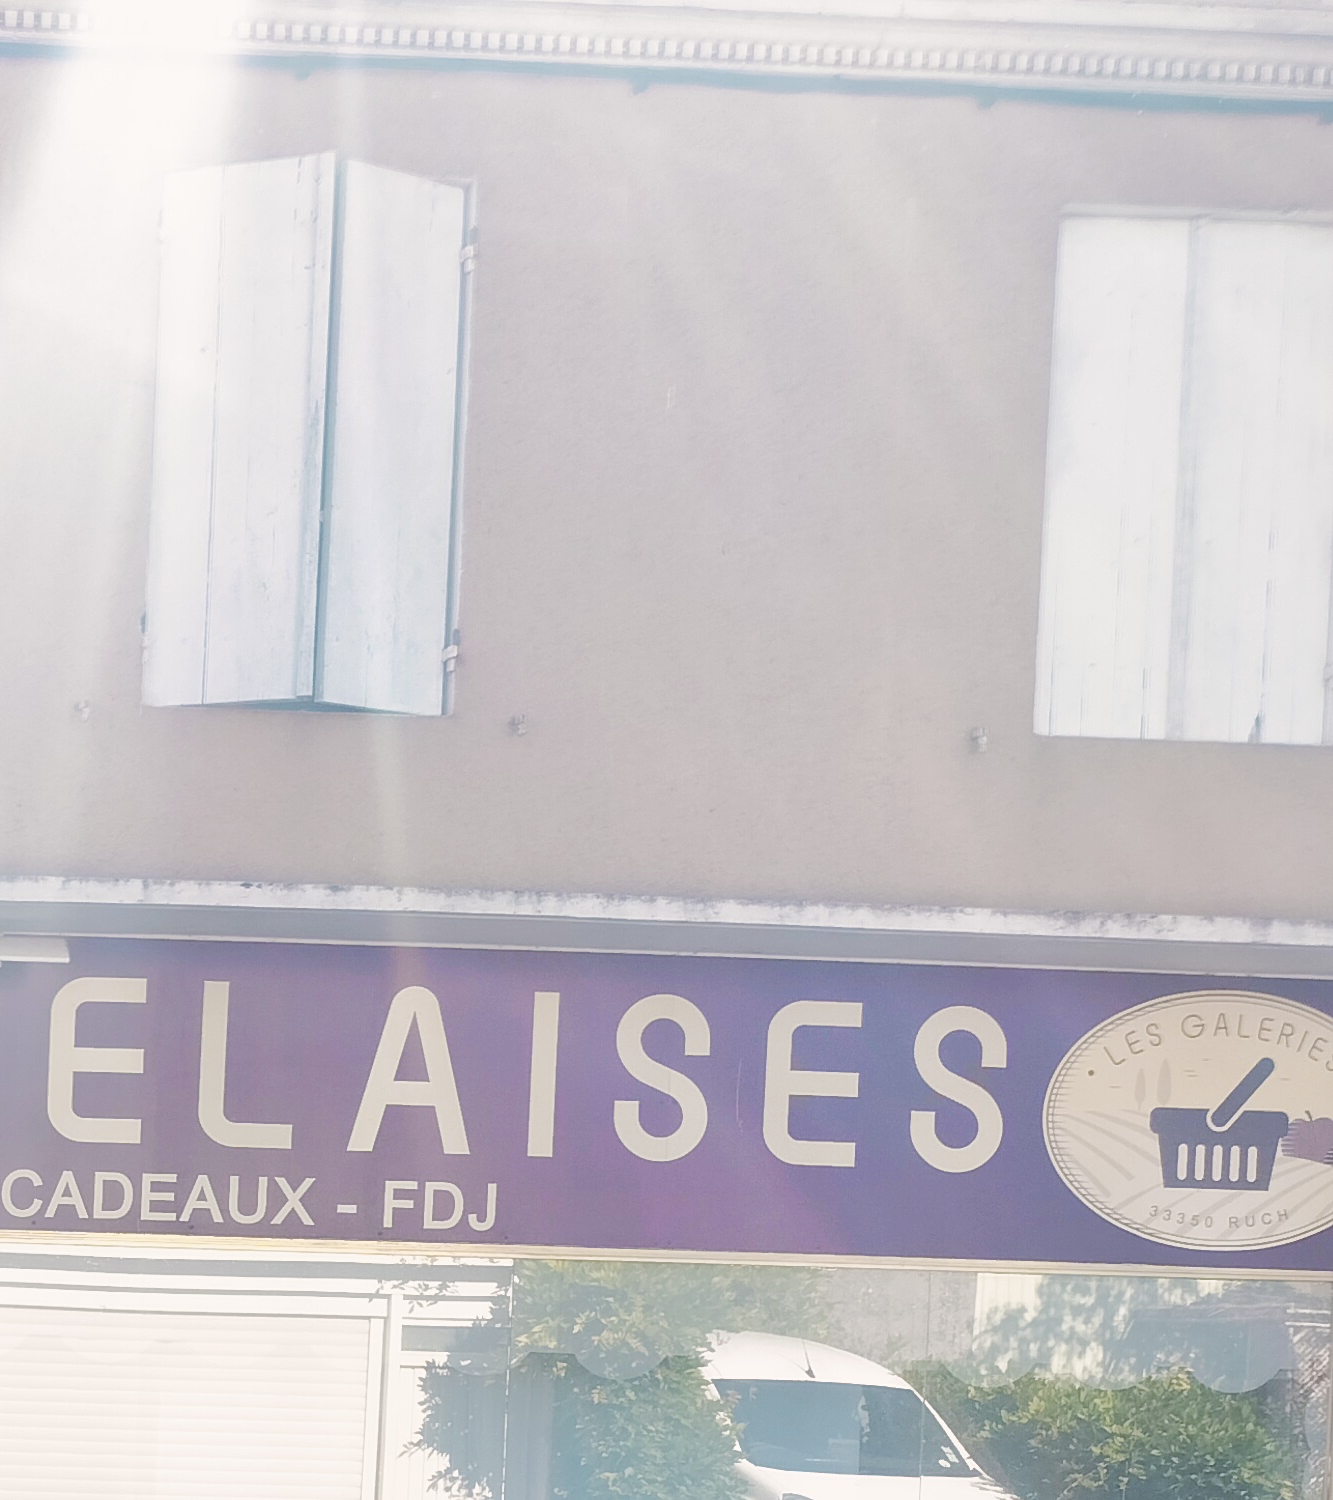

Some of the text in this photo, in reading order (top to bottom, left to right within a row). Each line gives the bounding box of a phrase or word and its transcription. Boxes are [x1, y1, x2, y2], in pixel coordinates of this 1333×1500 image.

[1103, 1022, 1163, 1066] LES
[1, 1169, 316, 1226] CADEAUX
[382, 1180, 498, 1232] FDJ
[1148, 1204, 1290, 1229] 33350 RUCH
